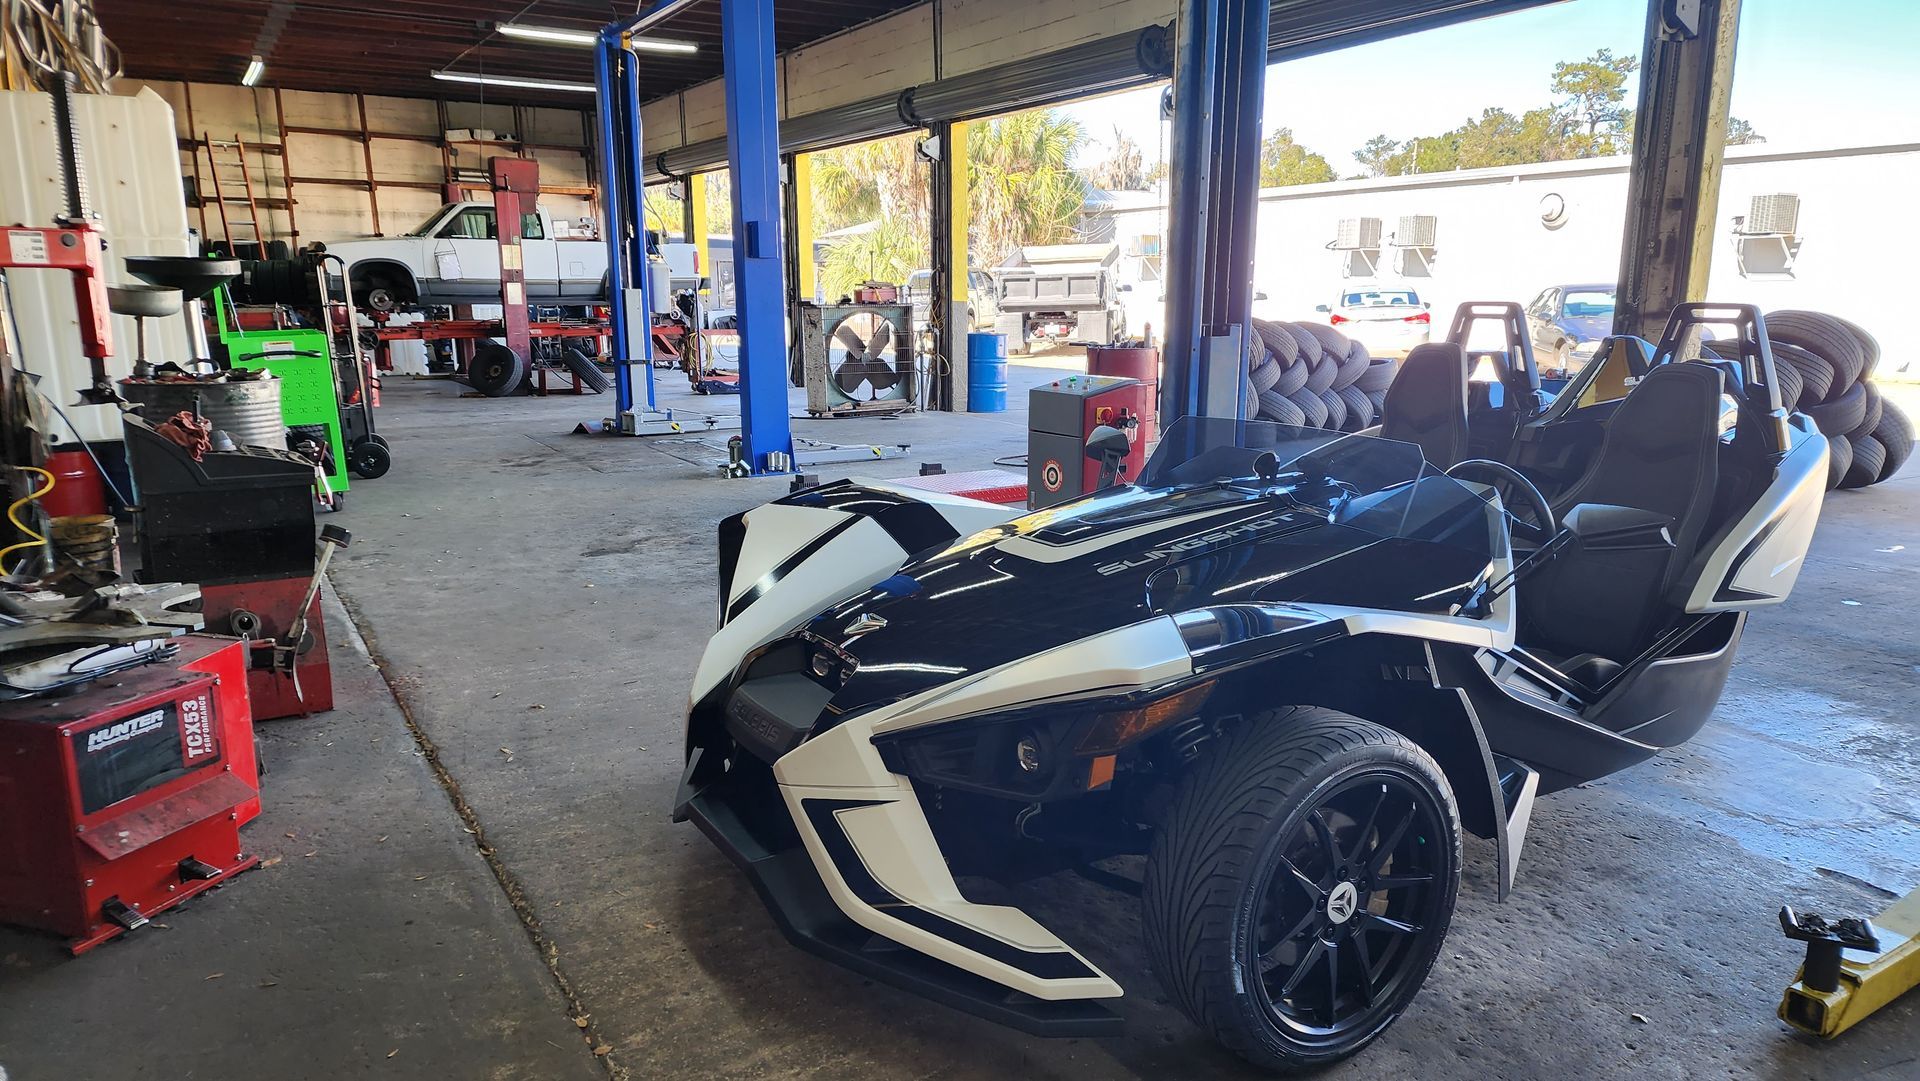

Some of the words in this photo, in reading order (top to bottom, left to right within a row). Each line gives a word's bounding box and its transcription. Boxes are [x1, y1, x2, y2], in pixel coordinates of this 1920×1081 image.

[1096, 513, 1294, 576] SLINGSHOT
[88, 709, 165, 746] HUNTER
[182, 699, 205, 758] TCX53
[198, 695, 211, 753] PERFORMANCE
